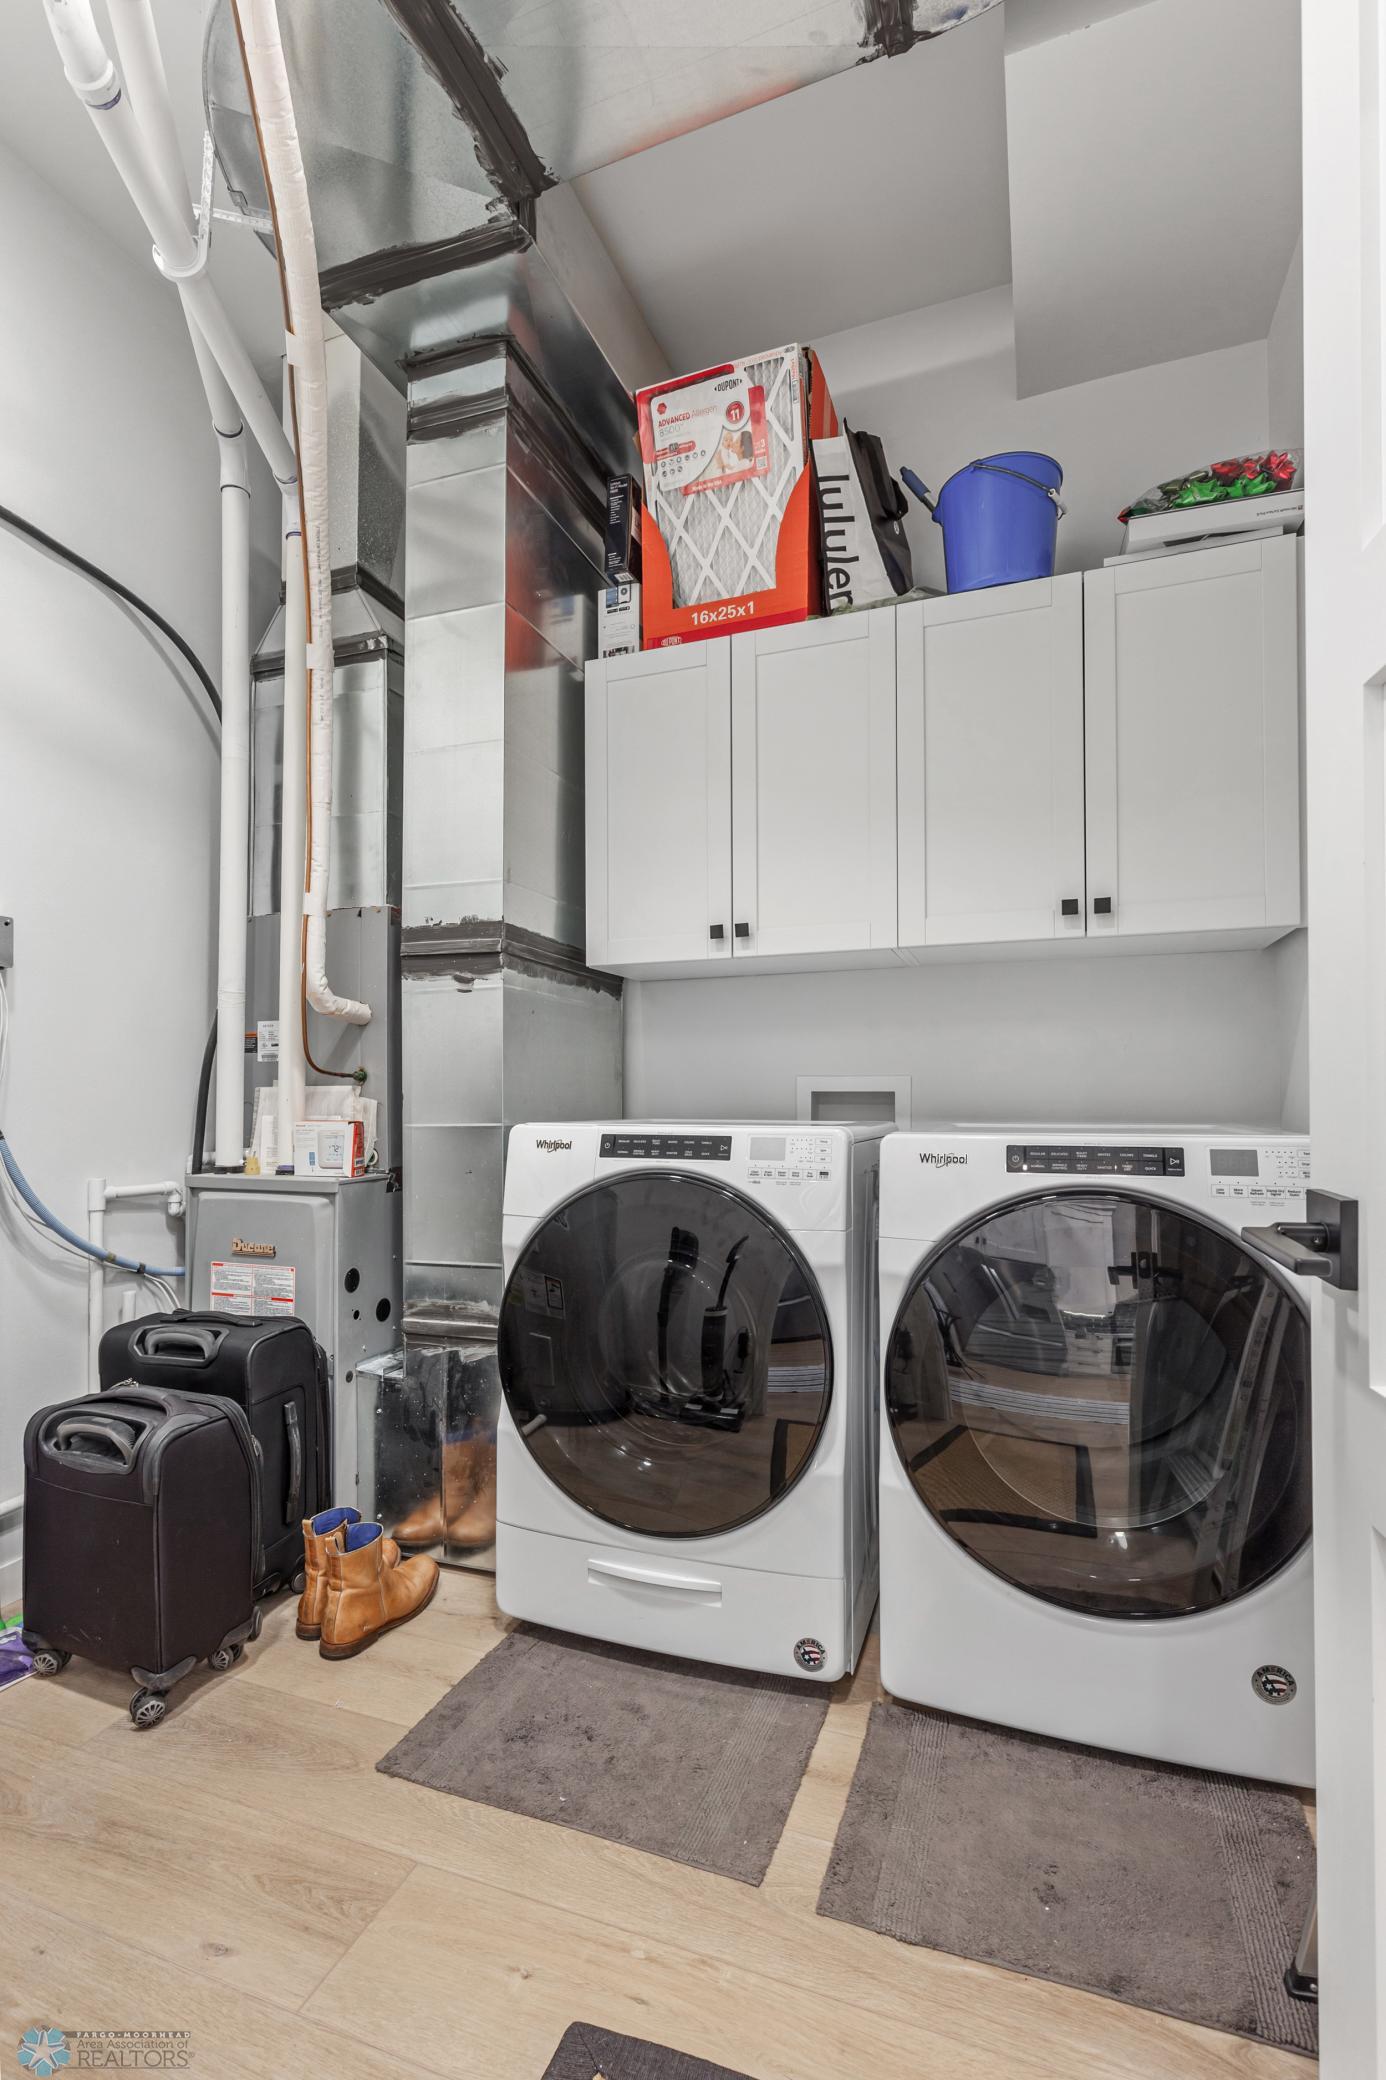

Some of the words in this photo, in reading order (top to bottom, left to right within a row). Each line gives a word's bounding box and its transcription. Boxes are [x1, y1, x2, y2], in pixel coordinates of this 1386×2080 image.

[716, 378, 740, 392] DUPONT
[658, 412, 691, 428] ADVANCED
[691, 601, 755, 626] 16x25x1
[536, 1139, 573, 1153] Whirlpool
[919, 1152, 968, 1168] Whirlpool
[796, 1639, 826, 1655] AMERICA
[1256, 1666, 1295, 1686] AMERICA
